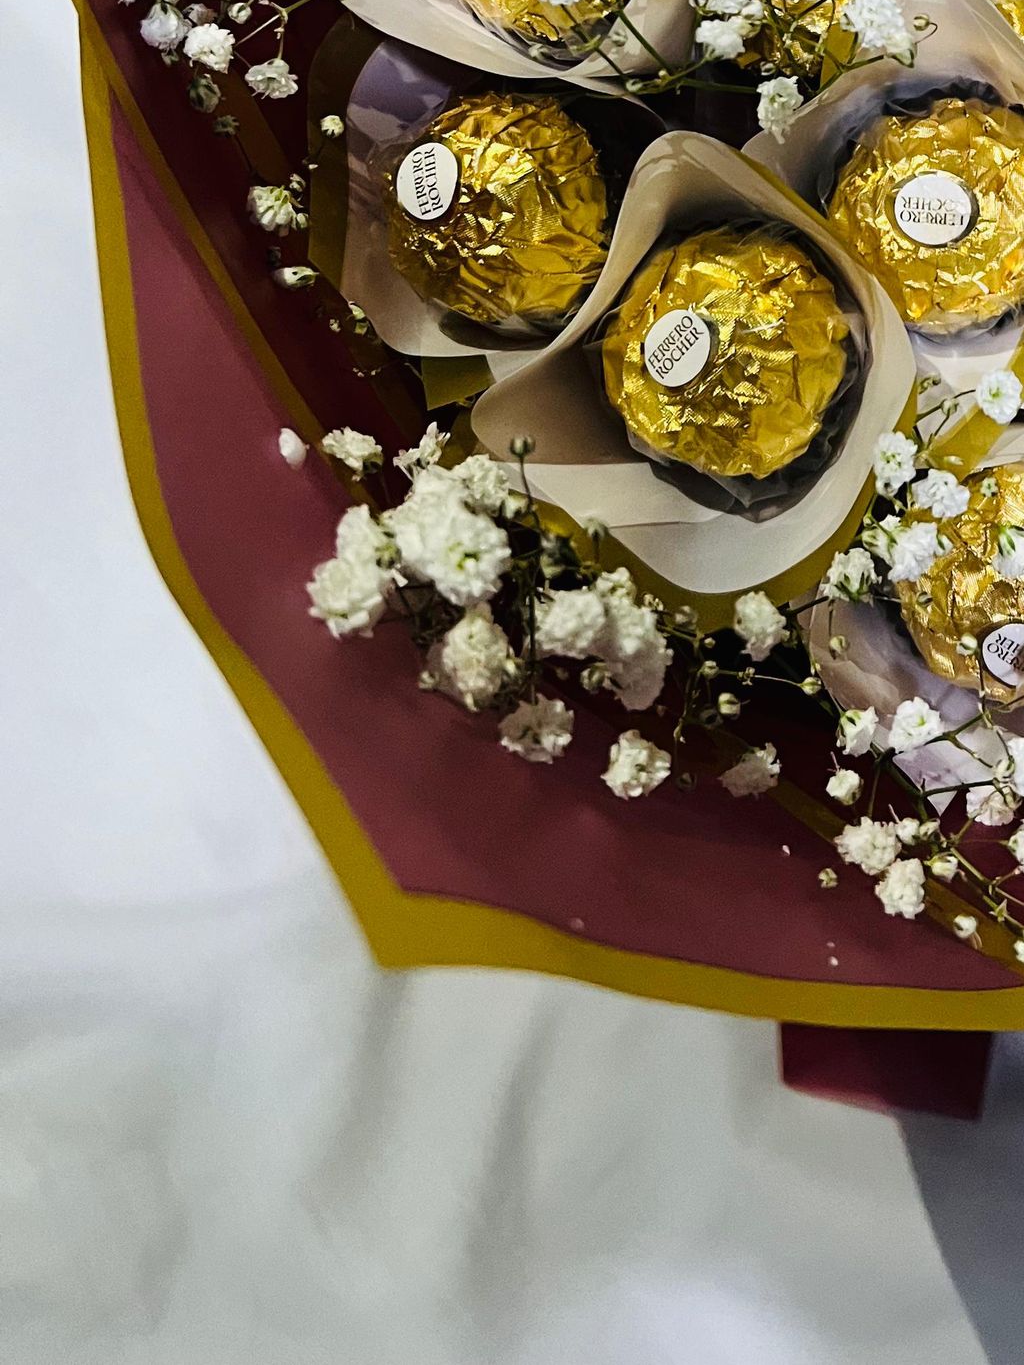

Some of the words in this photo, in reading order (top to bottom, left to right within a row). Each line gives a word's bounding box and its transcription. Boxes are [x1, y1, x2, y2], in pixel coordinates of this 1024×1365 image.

[411, 151, 432, 216] FERRERO
[424, 146, 444, 211] ROCHER
[647, 315, 694, 369] FERRERO
[655, 326, 705, 380] ROCHER
